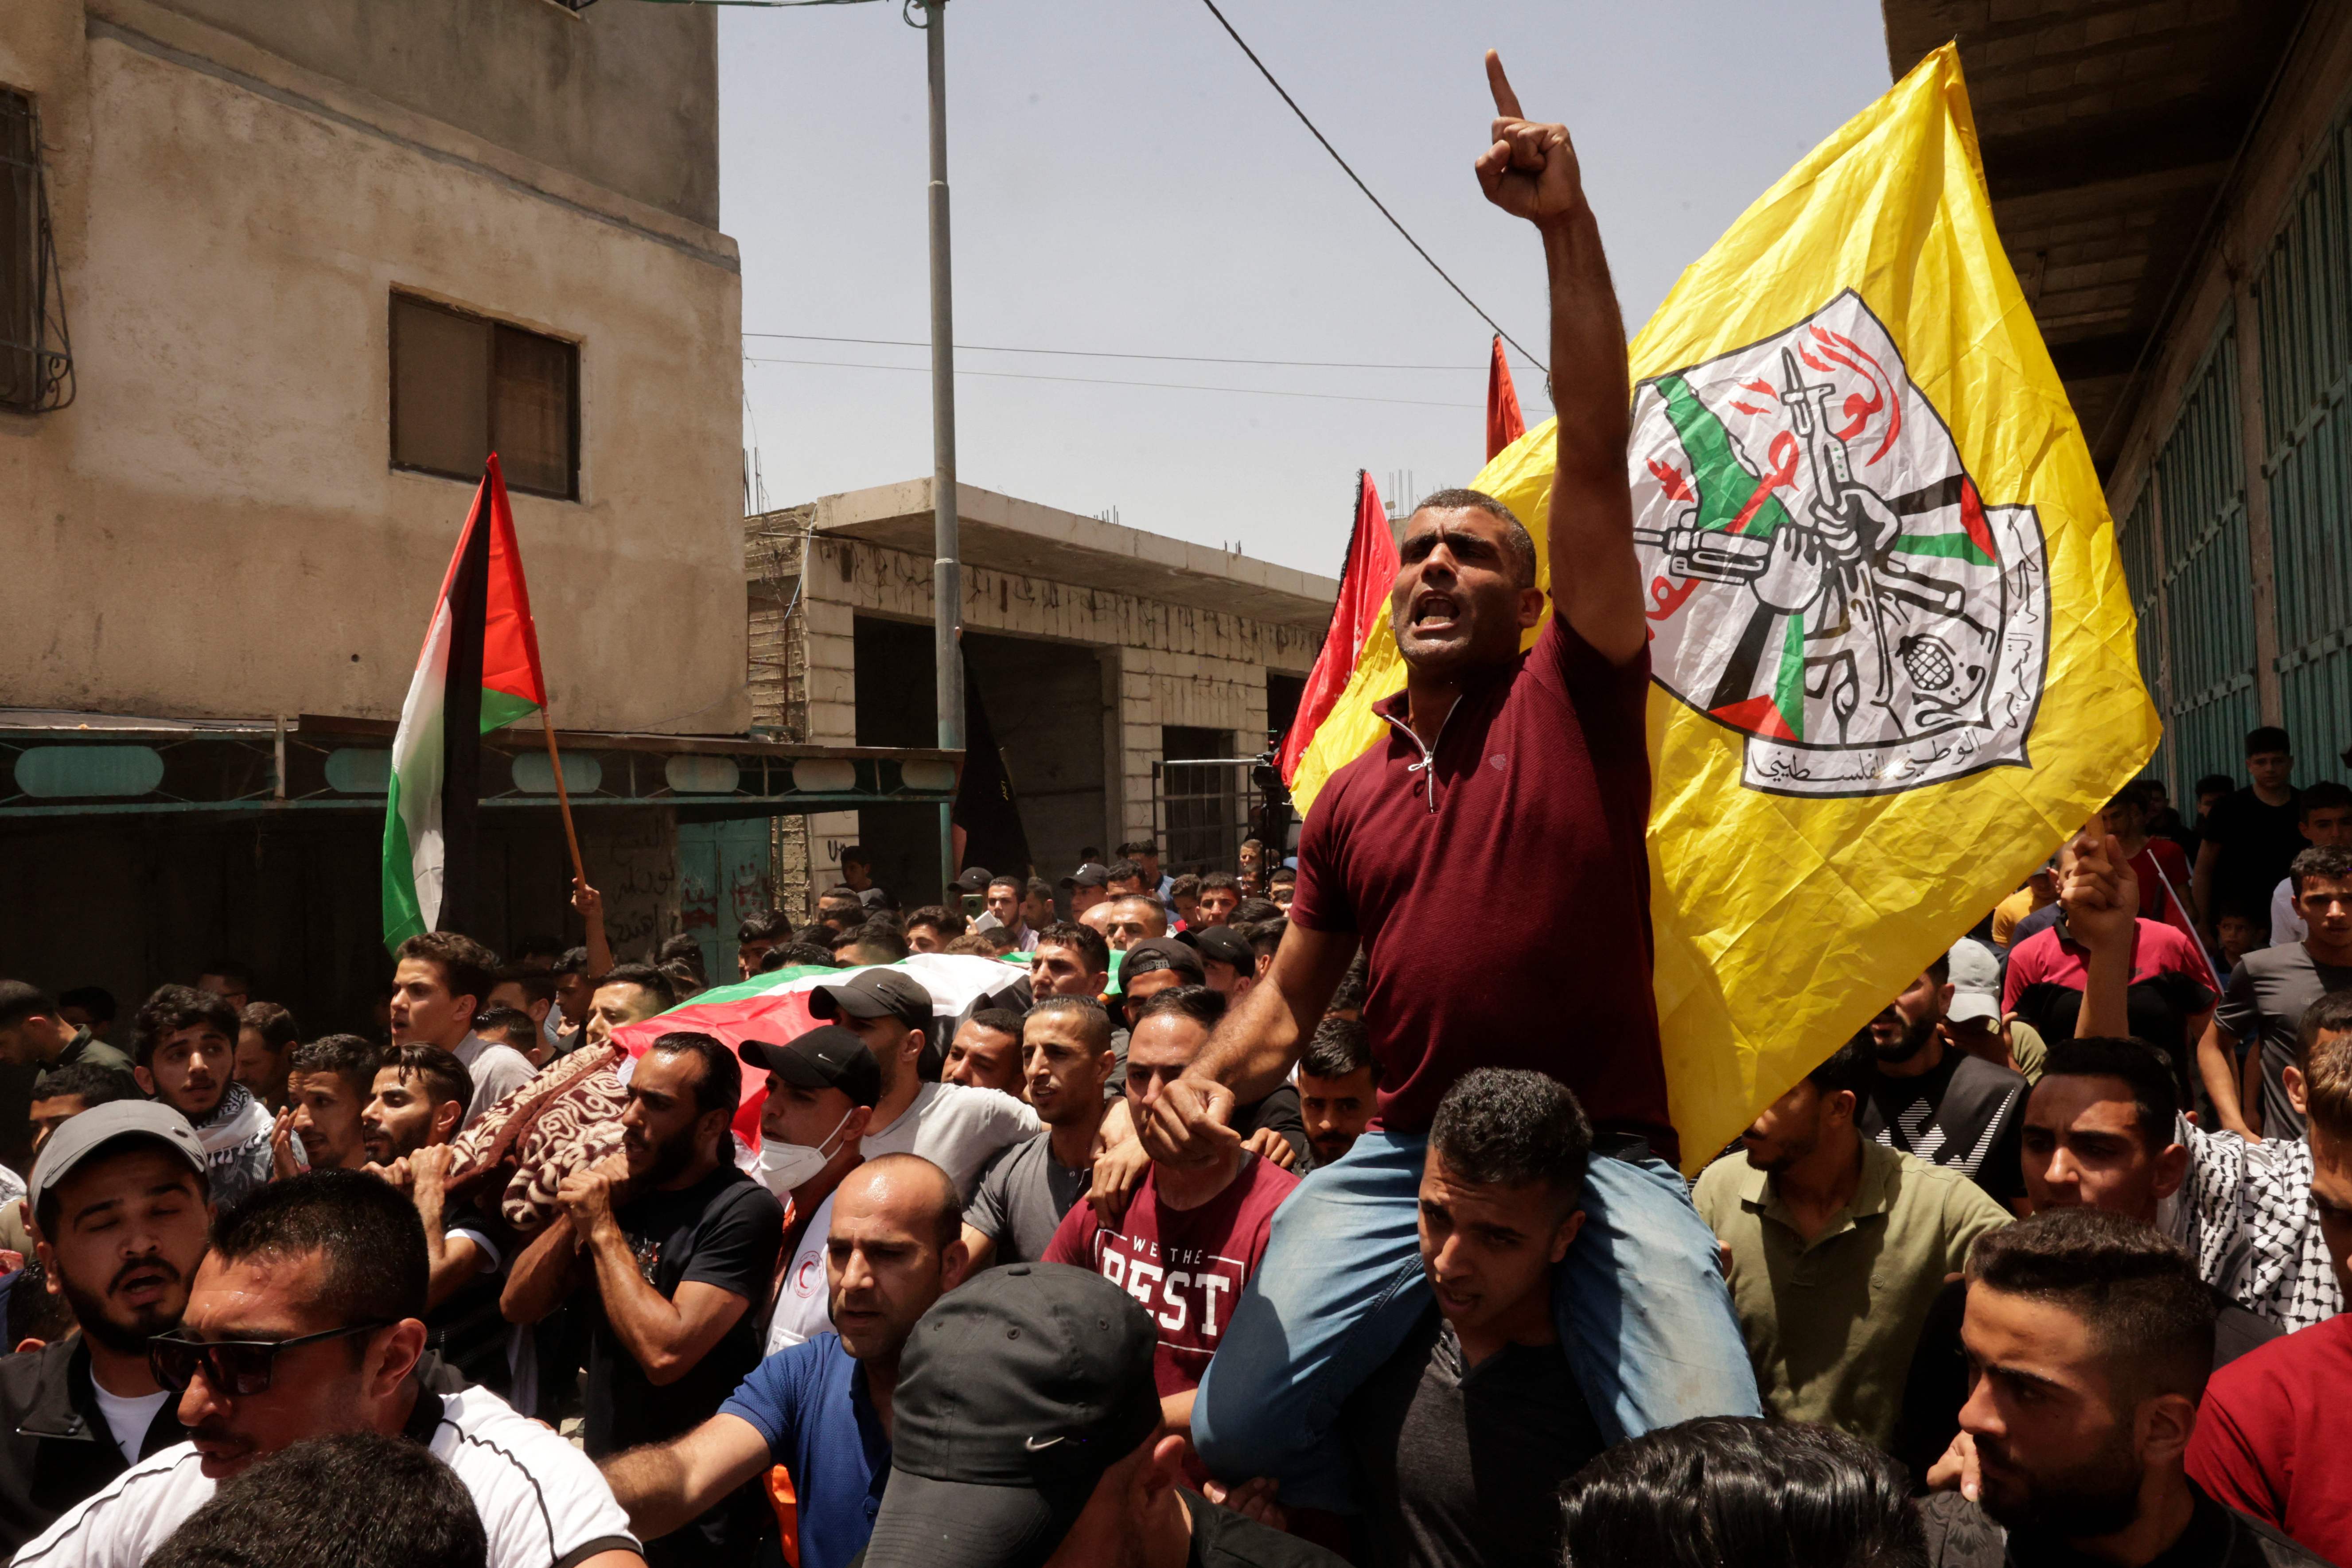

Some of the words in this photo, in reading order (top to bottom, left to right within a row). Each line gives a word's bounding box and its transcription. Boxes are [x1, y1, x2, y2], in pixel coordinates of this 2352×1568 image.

[2005, 514, 2039, 624] حركة
[1912, 661, 1986, 728] فتح
[2004, 632, 2034, 729] التحرير
[1751, 750, 1886, 782] الفلسطيني
[1895, 729, 1982, 781] الوطني
[1133, 1235, 1158, 1257] WE
[1170, 1248, 1203, 1265] THE
